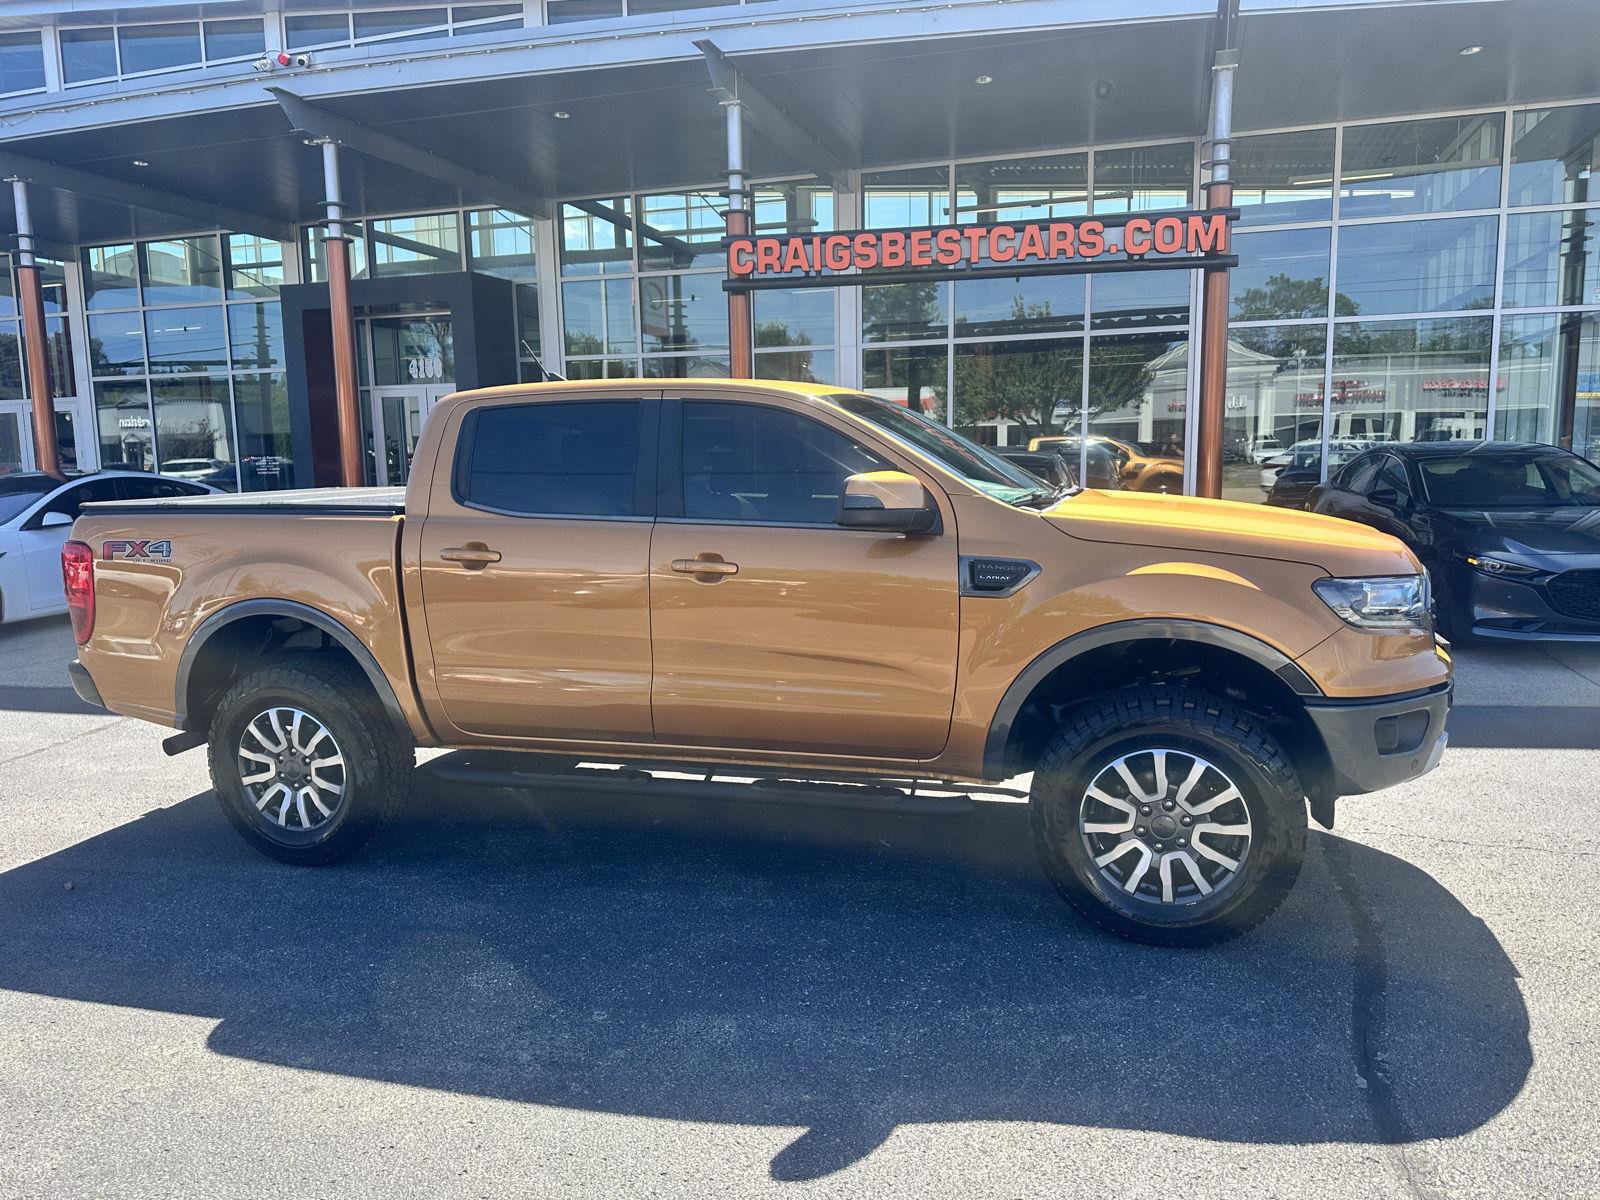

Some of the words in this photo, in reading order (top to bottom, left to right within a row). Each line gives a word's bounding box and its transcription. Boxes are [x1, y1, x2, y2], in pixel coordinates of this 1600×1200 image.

[729, 214, 1228, 275] CRAIGSBESTCARS.COM
[102, 540, 172, 561] FX4
[977, 564, 1026, 572] RANGER
